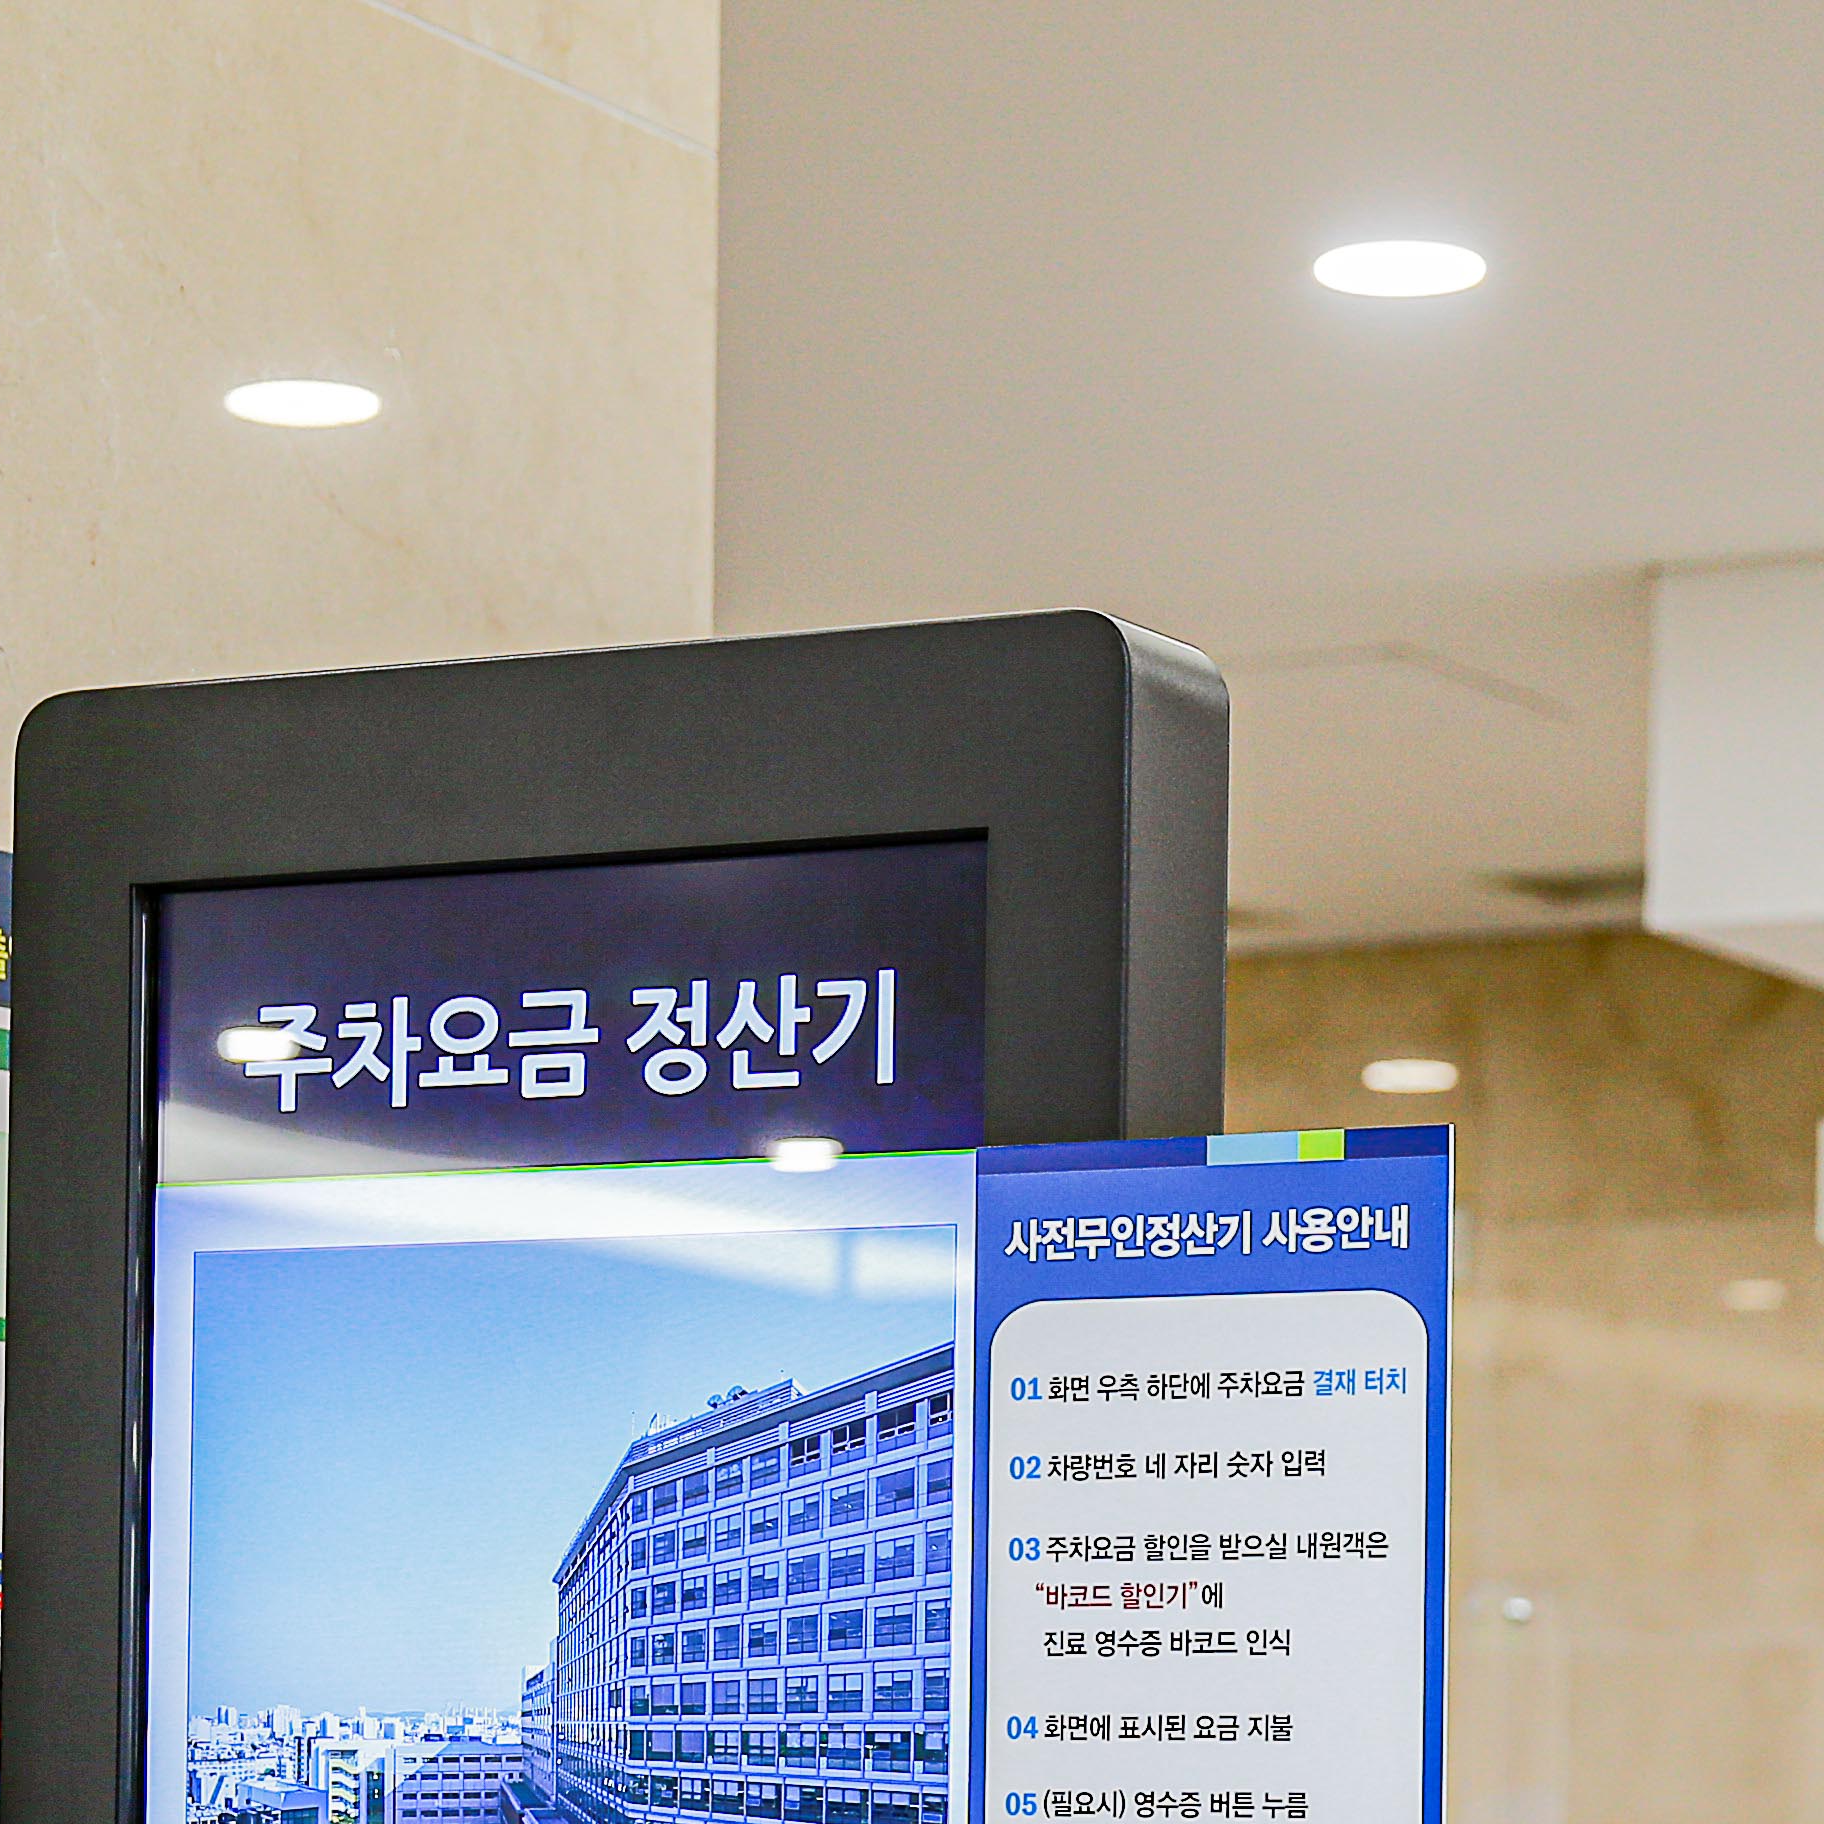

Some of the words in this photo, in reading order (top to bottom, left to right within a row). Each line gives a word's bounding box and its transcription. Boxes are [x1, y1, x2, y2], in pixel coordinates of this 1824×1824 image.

[241, 989, 600, 1112] 주차요금
[626, 968, 897, 1097] 정산기
[1002, 1208, 1253, 1264] 사전무인정산기
[1260, 1202, 1411, 1255] 사용안내
[1010, 1377, 1043, 1402] 01
[1048, 1375, 1090, 1403] 화면
[1096, 1373, 1140, 1402] 우측
[1146, 1372, 1211, 1401] 하단에
[1217, 1370, 1305, 1399] 주차요금
[1313, 1368, 1356, 1397] 결재
[1364, 1367, 1407, 1395] 터치
[1009, 1455, 1042, 1480] 02
[1047, 1453, 1137, 1482] 차량번호
[1145, 1452, 1166, 1480] 네
[1173, 1451, 1218, 1480] 자리
[1226, 1450, 1274, 1479] 숫자
[1281, 1449, 1325, 1477] 입력
[1008, 1537, 1041, 1562] 03
[1045, 1535, 1136, 1563] 주차요금
[1143, 1533, 1212, 1562] 할인을
[1219, 1532, 1287, 1561] 받으실
[1297, 1531, 1389, 1560] 내원객은
[1035, 1582, 1113, 1611] “바코드
[1120, 1580, 1223, 1610] 할인기”에
[1043, 1630, 1088, 1657] 진료
[1095, 1629, 1163, 1658] 영수증
[1170, 1629, 1239, 1657] 바코드
[1246, 1628, 1291, 1657] 인식
[1006, 1715, 1039, 1740] 04
[1044, 1714, 1111, 1742] 화면에
[1118, 1714, 1186, 1742] 표시된
[1193, 1715, 1240, 1742] 요금
[1247, 1714, 1294, 1742] 지불
[1005, 1791, 1038, 1817] 05
[1043, 1789, 1126, 1819] (필요시)
[1134, 1790, 1202, 1819] 영수증
[1210, 1791, 1255, 1819] 버튼
[1261, 1792, 1309, 1819] 누름
